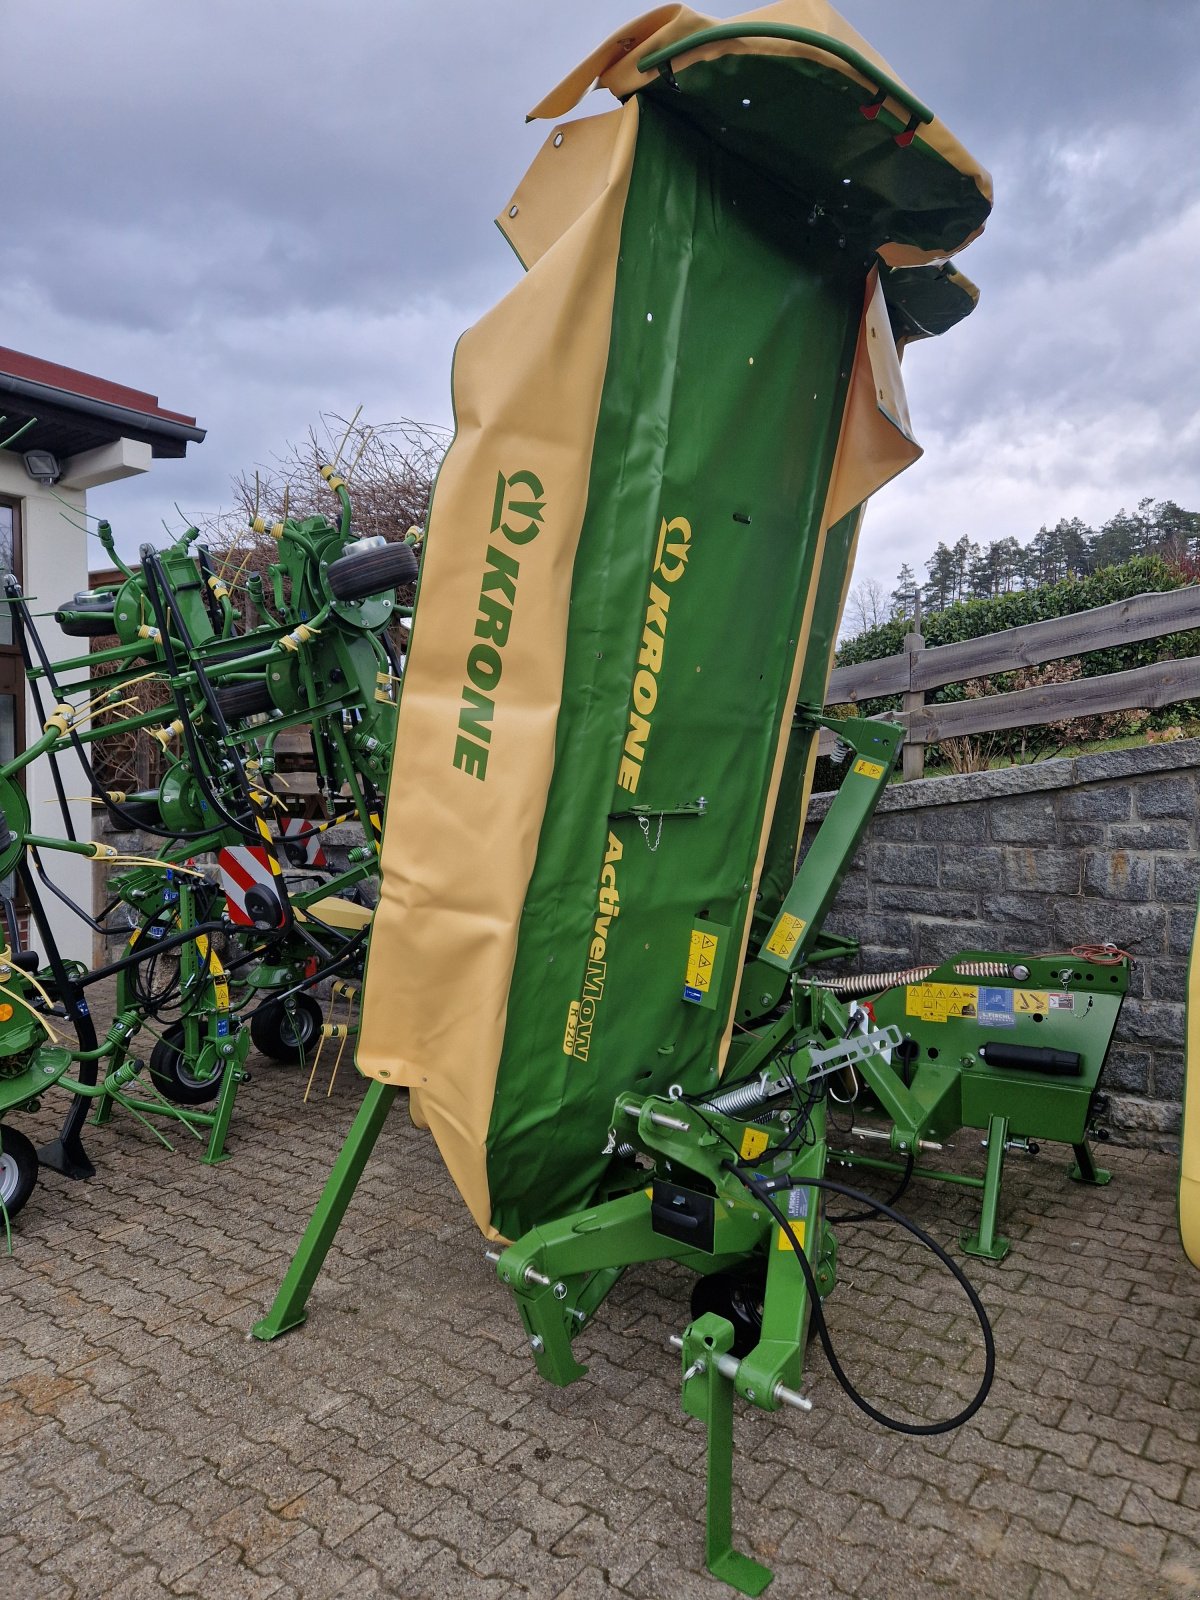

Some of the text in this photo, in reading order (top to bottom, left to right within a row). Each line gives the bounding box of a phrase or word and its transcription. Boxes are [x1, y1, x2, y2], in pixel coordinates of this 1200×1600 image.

[453, 547, 519, 780] KRONE
[617, 583, 671, 793] KRONE
[565, 1023, 576, 1048] 320
[573, 831, 624, 1062] ActiveMow
